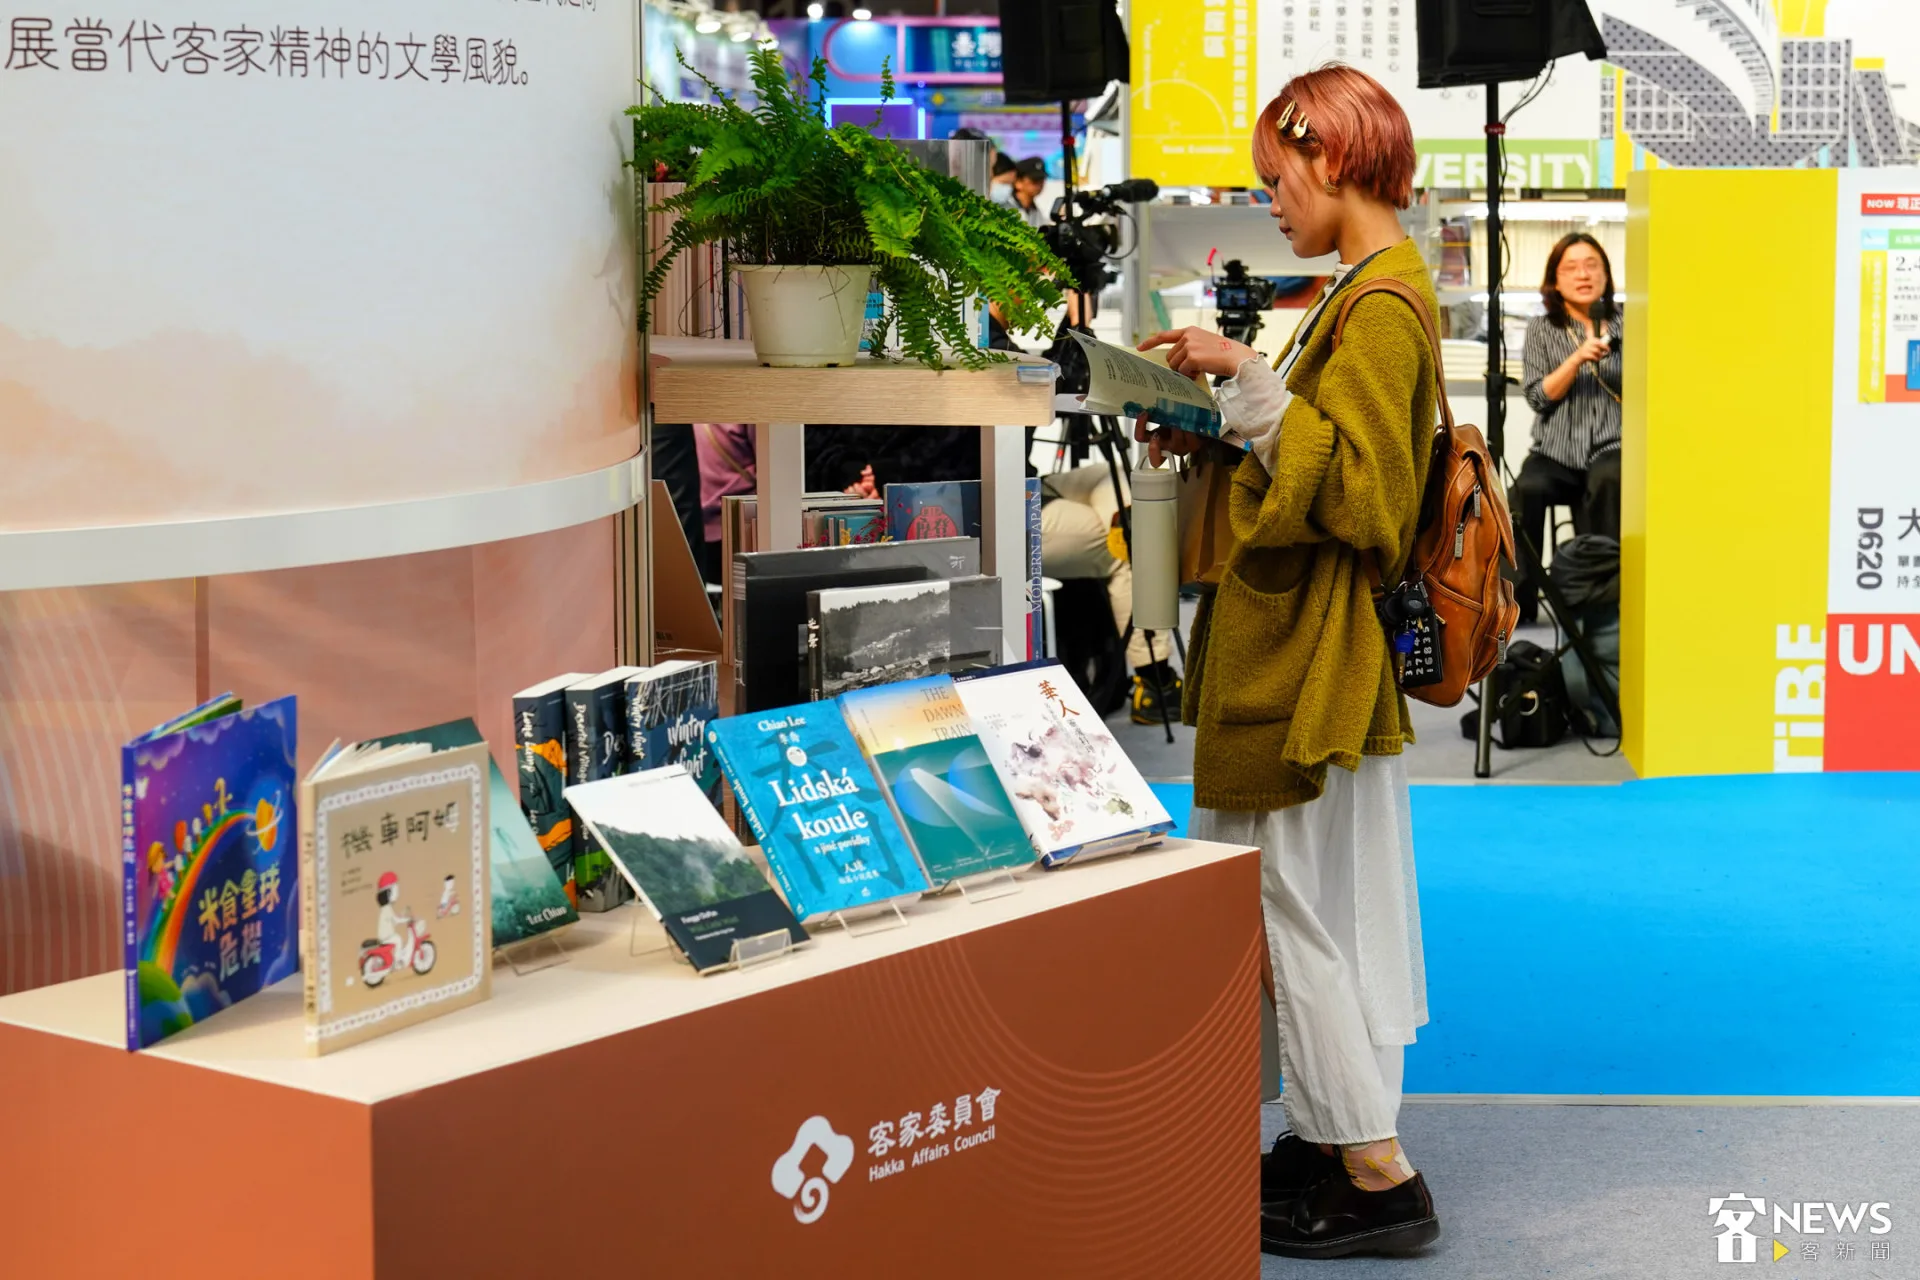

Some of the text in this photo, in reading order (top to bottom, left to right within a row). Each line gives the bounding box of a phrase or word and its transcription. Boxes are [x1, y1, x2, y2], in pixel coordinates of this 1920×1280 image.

[1866, 198, 1895, 209] NOW
[1031, 490, 1042, 613] MODERN JAPAN
[1856, 507, 1884, 591] D620
[920, 685, 950, 702] THE
[757, 715, 807, 732] Chiao Lee
[922, 703, 965, 723] DAWN
[767, 767, 860, 807] Lidská
[791, 803, 869, 840] koule
[867, 1085, 1002, 1158] 客家委員會
[868, 1124, 997, 1183] Hakka Affairs Council
